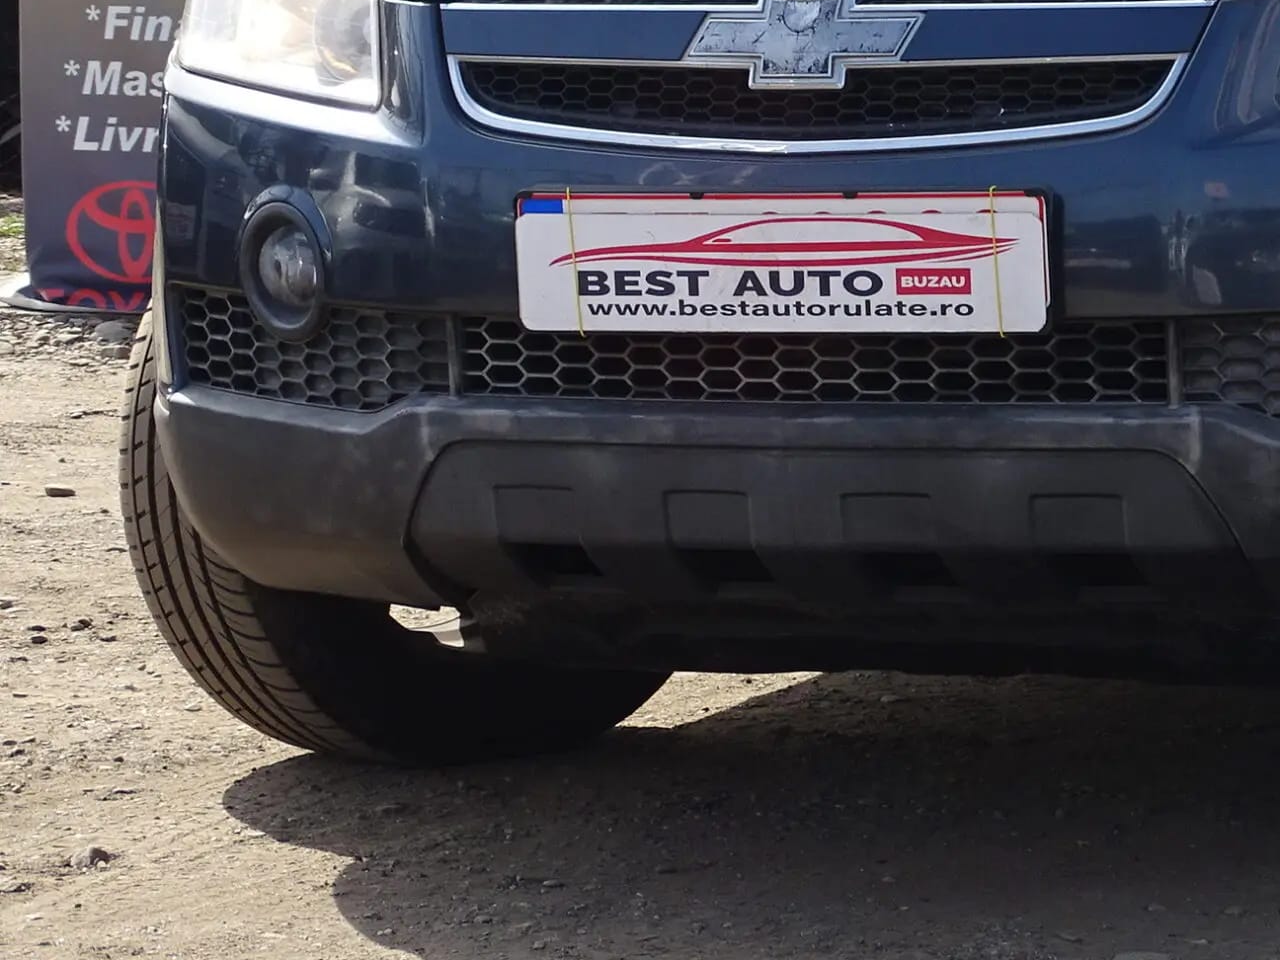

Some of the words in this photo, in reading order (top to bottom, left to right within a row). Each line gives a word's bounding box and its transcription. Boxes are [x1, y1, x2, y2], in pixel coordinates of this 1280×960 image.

[577, 270, 709, 297] BEST
[732, 270, 884, 297] AUTO
[901, 276, 966, 288] BUZAU
[587, 299, 974, 317] www.bestautorulate.ro
